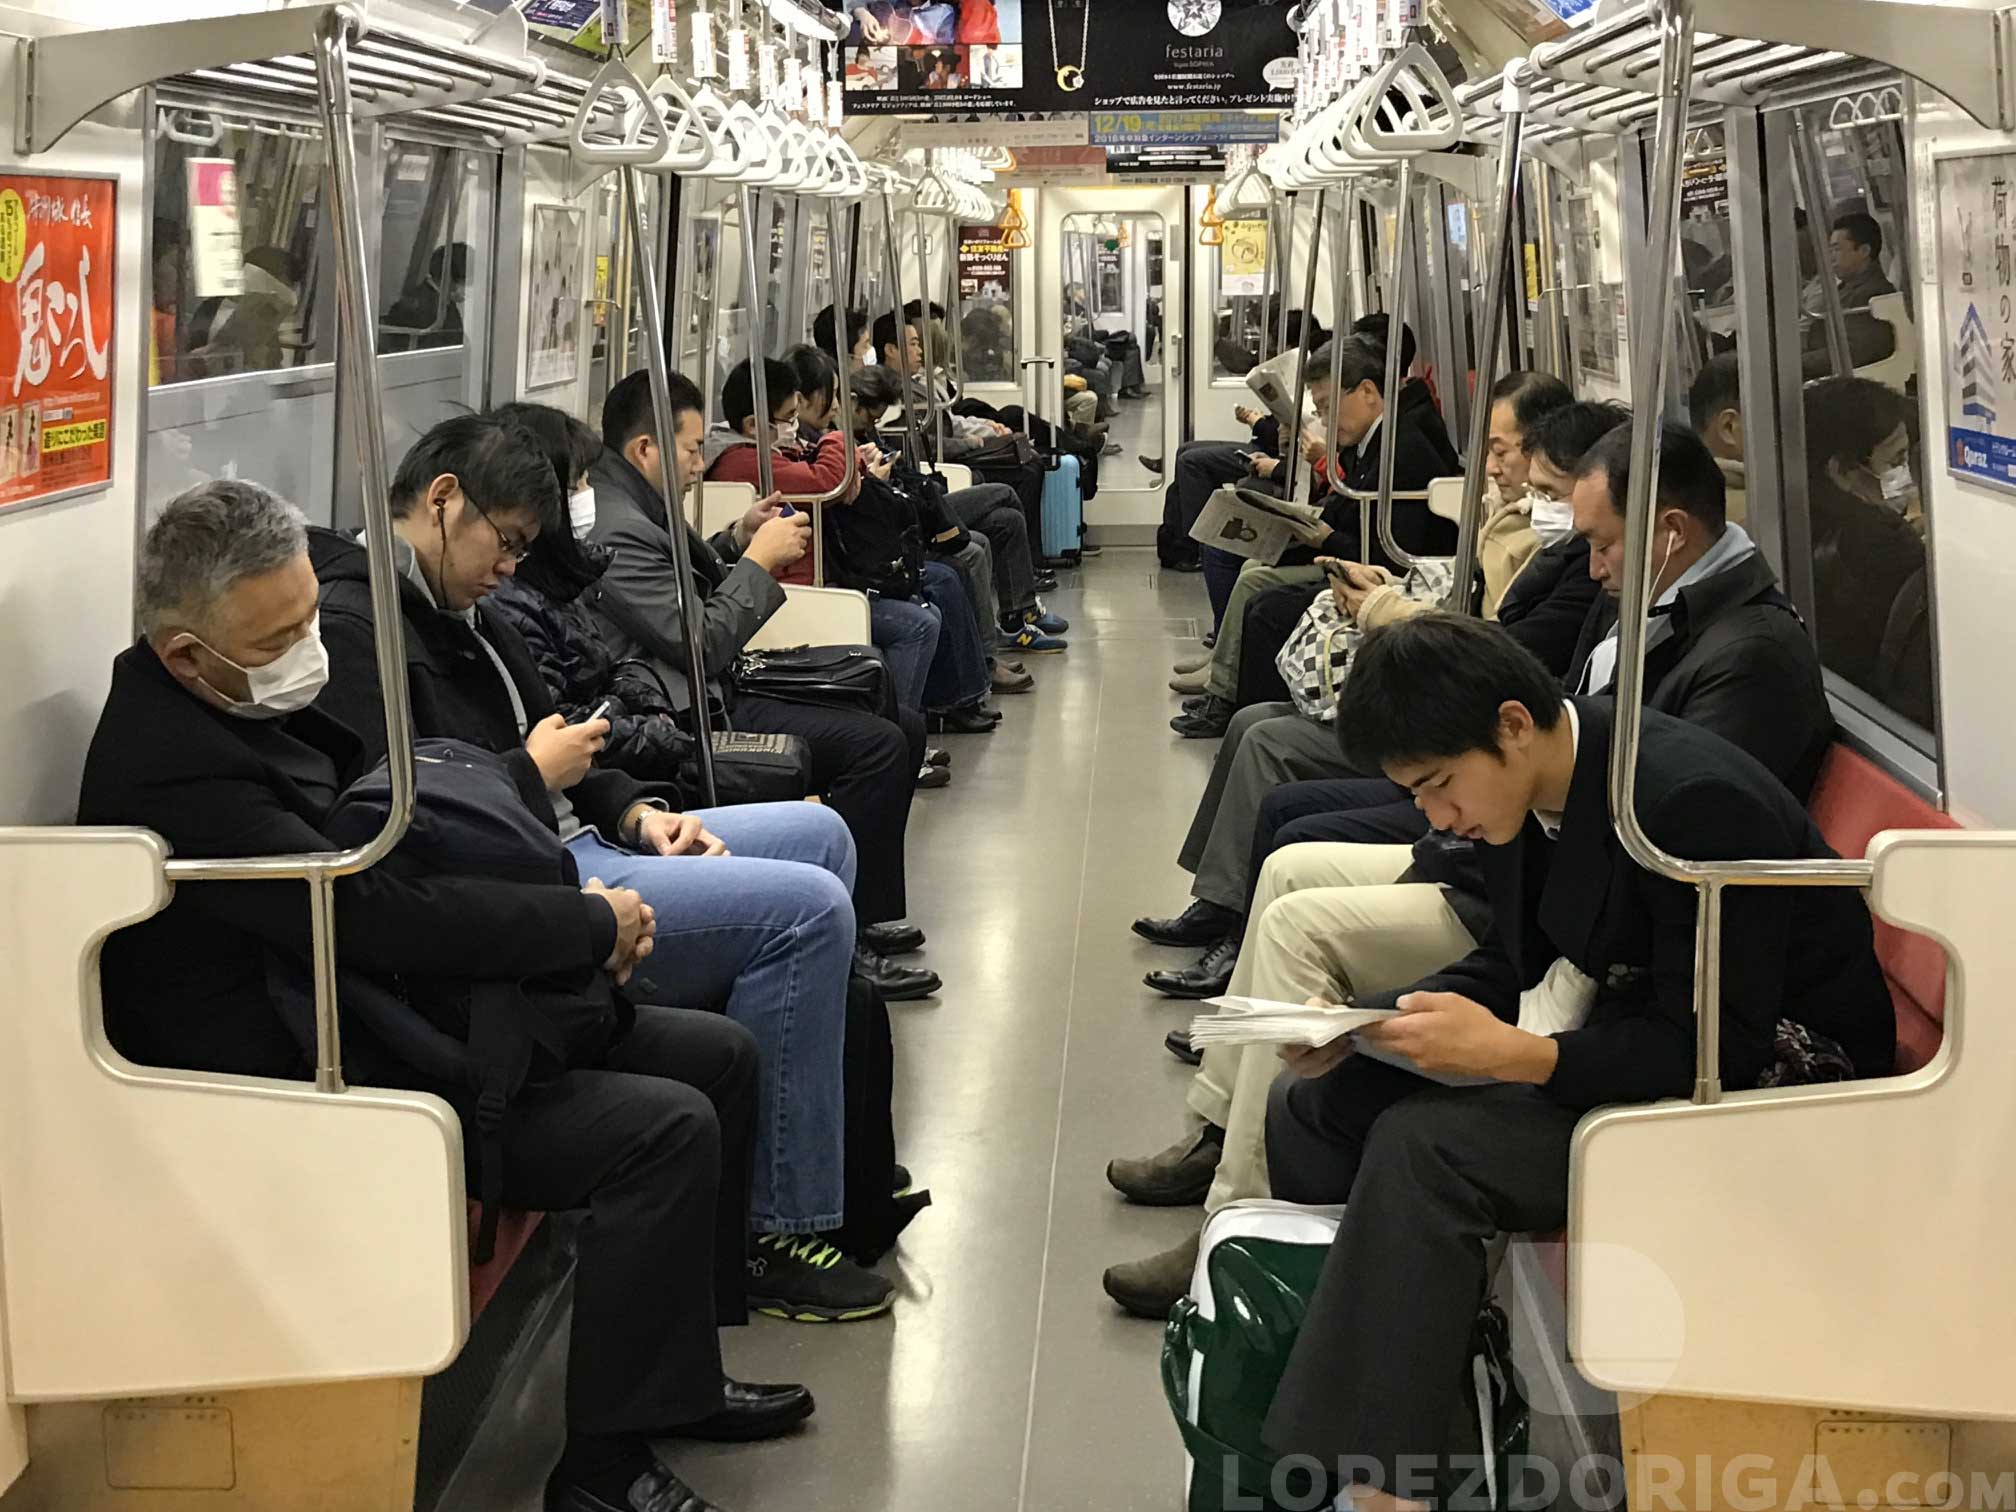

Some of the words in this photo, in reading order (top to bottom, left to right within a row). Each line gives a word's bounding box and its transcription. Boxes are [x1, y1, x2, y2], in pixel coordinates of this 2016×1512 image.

[1165, 44, 1224, 58] festaria
[1991, 174, 2016, 385] 荷物の家
[1016, 633, 1032, 646] N
